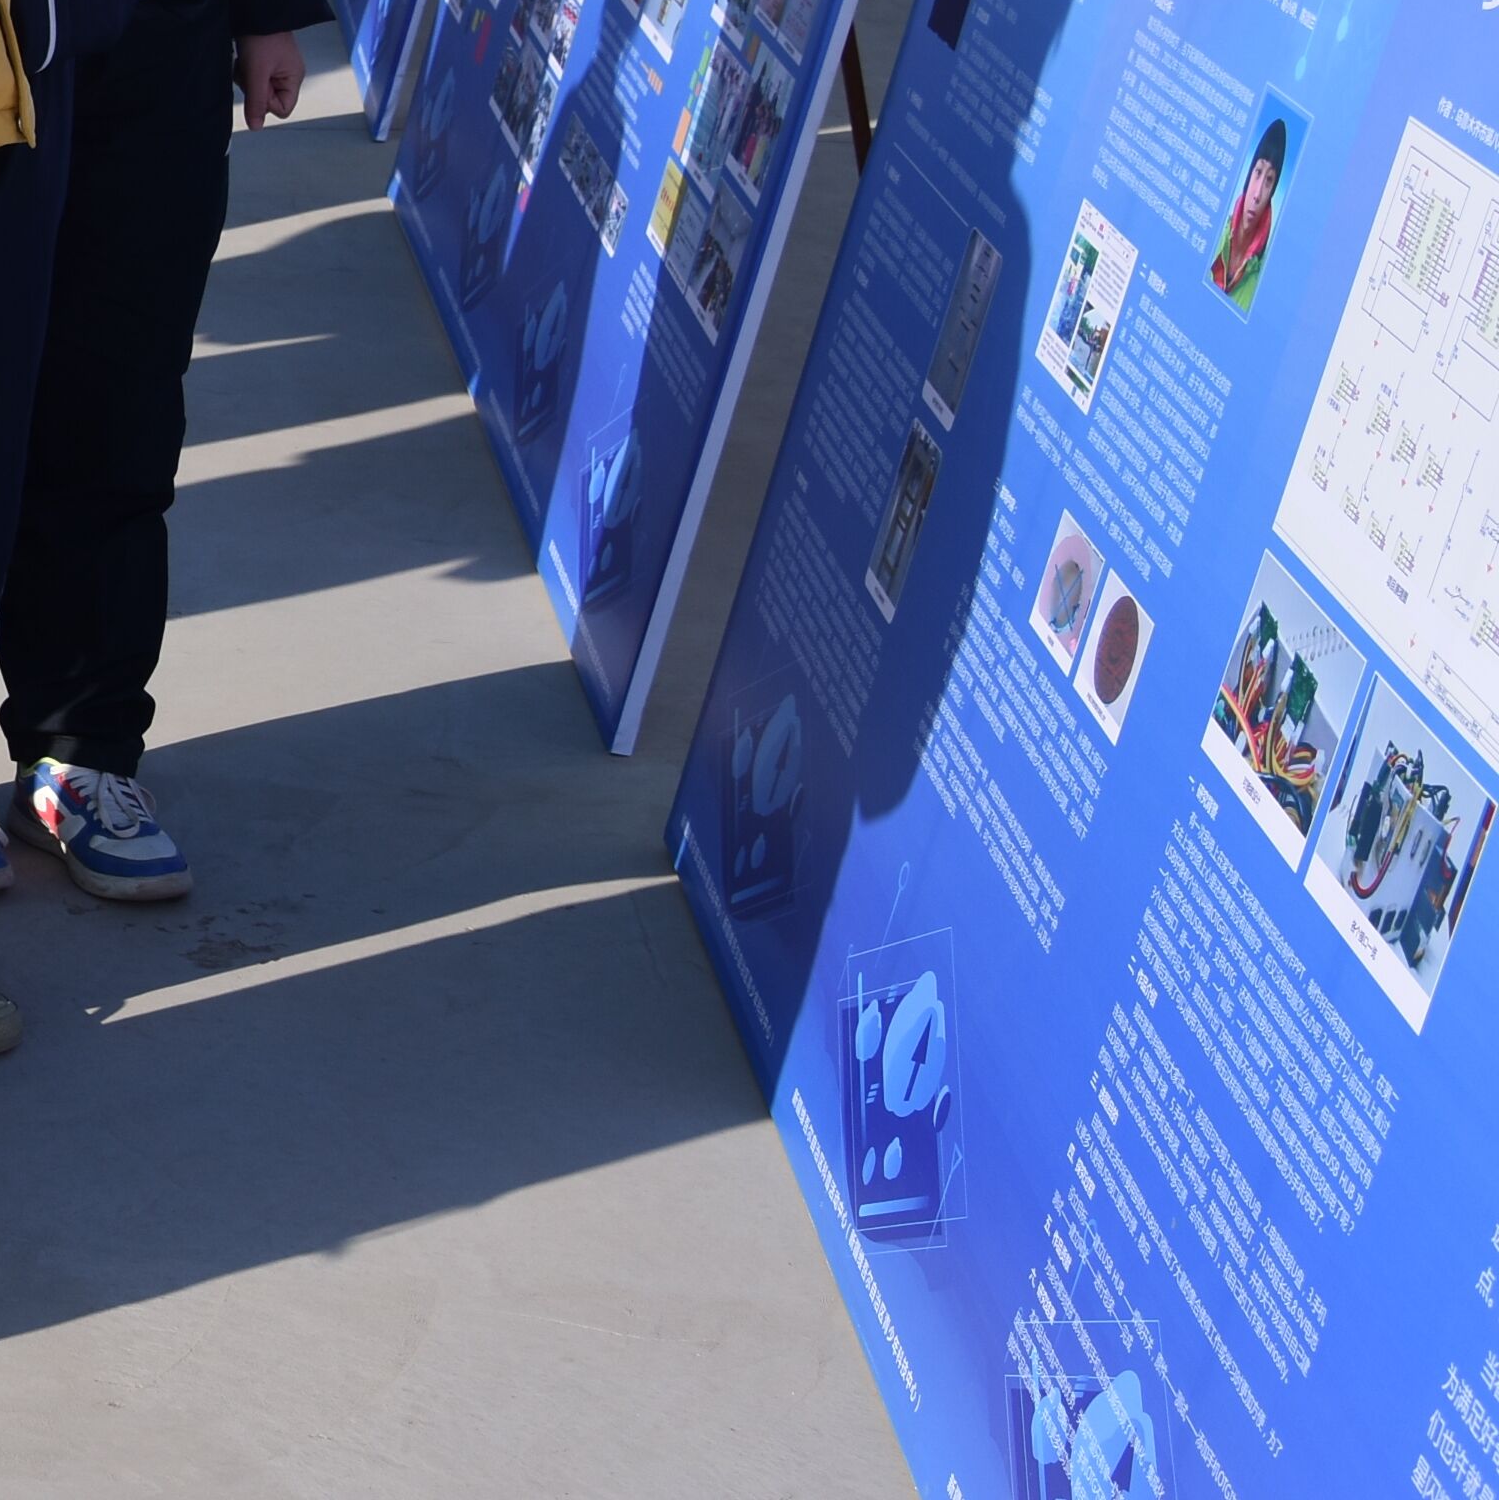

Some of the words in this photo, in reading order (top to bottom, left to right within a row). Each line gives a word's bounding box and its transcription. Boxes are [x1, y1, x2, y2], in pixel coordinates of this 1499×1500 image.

[1437, 96, 1499, 153] 作者：乌鲁木齐市第八
[1338, 1170, 1355, 1203] HUB
[1475, 1266, 1496, 1308] 点。
